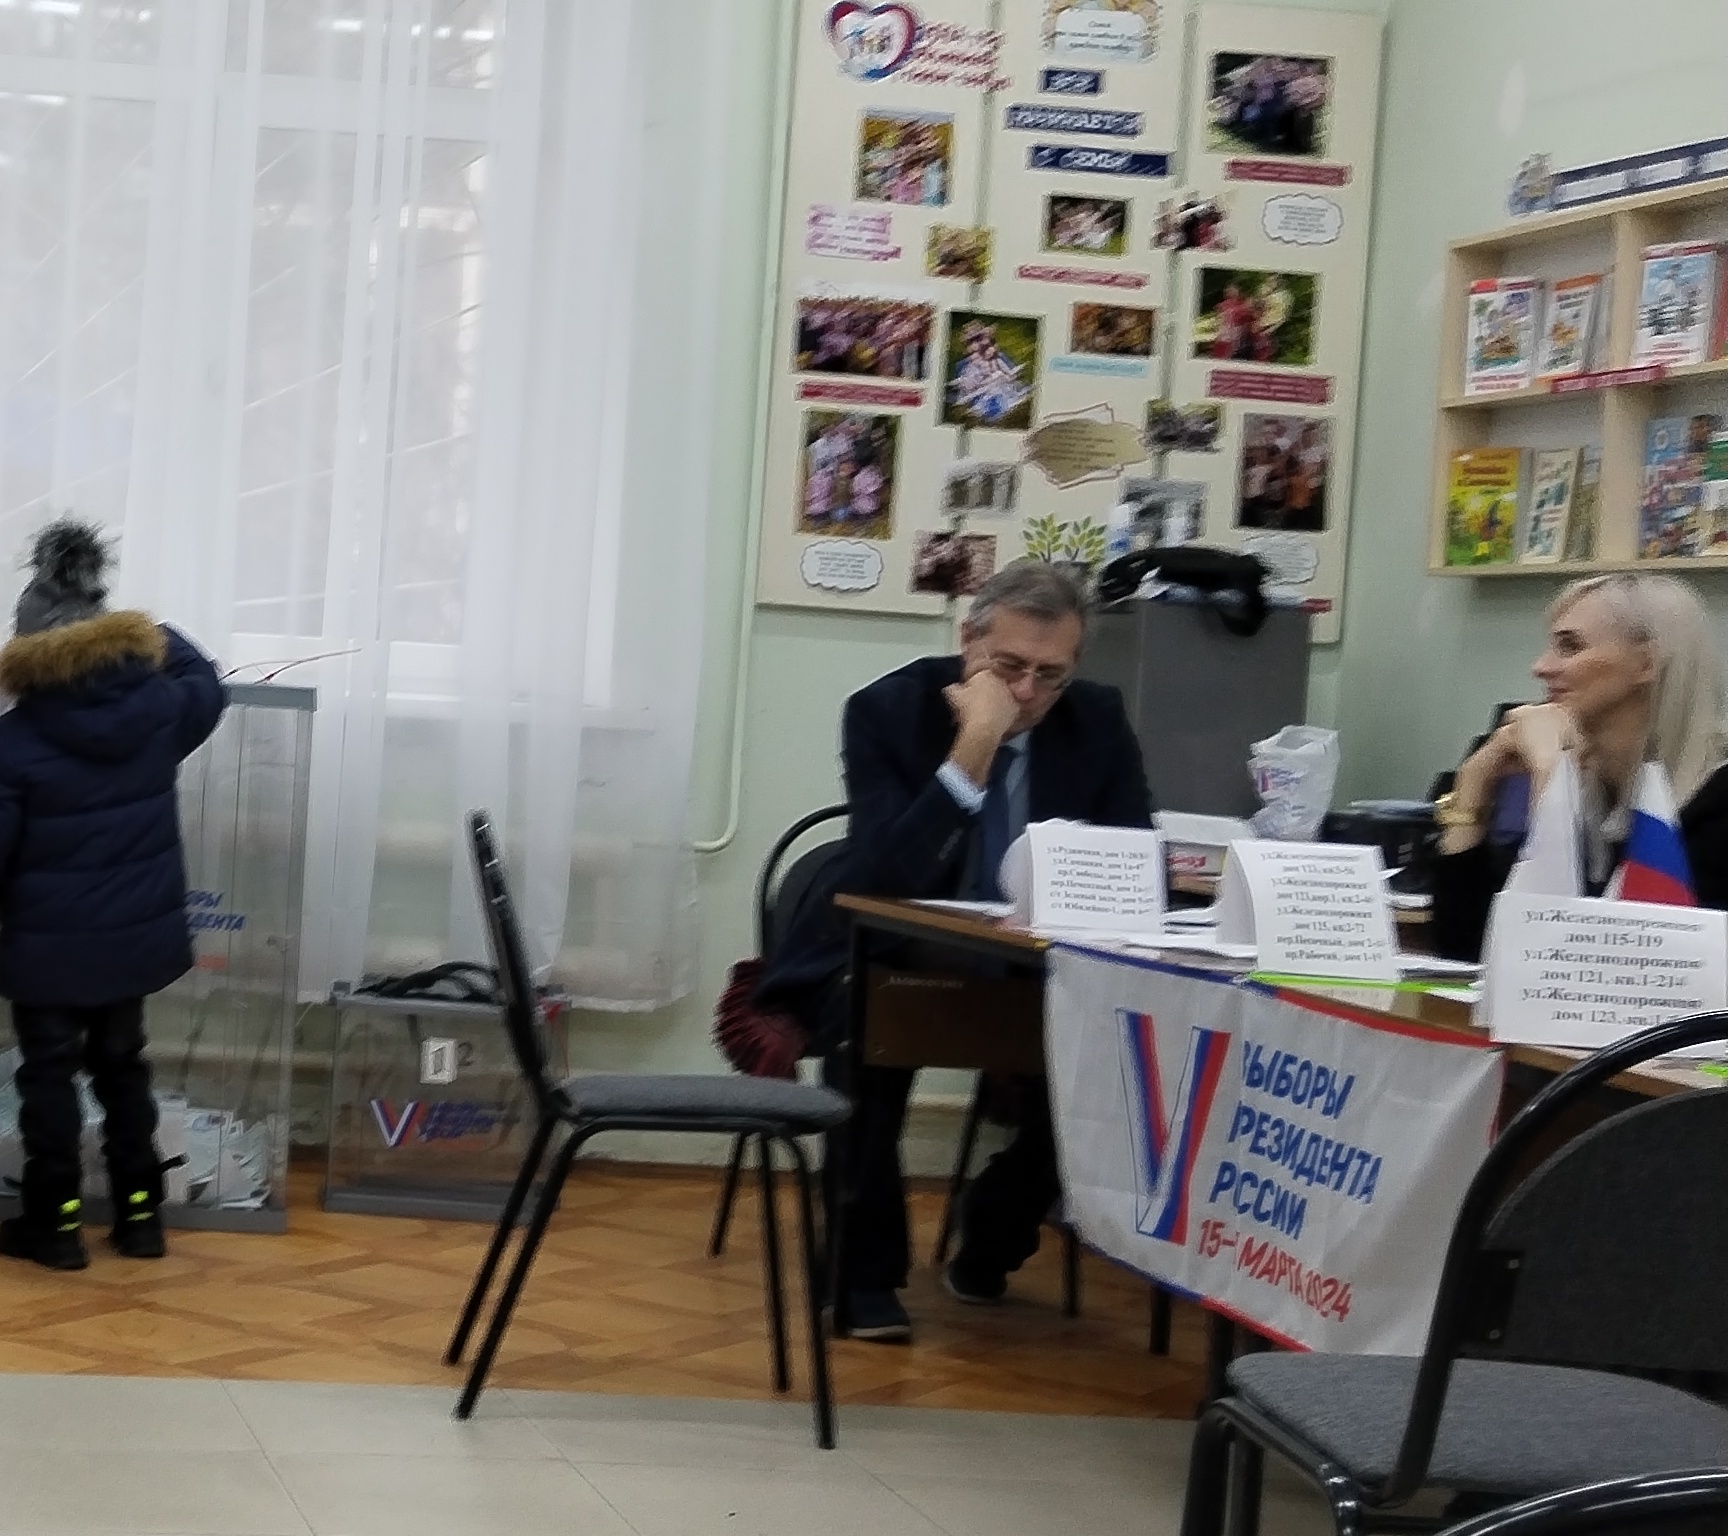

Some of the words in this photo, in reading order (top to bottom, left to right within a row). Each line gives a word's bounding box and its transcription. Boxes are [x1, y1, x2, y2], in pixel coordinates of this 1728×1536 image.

[1564, 932, 1596, 944] дом
[1603, 932, 1664, 948] 115-119
[1539, 969, 1572, 982] дом
[1551, 1009, 1584, 1021] дом
